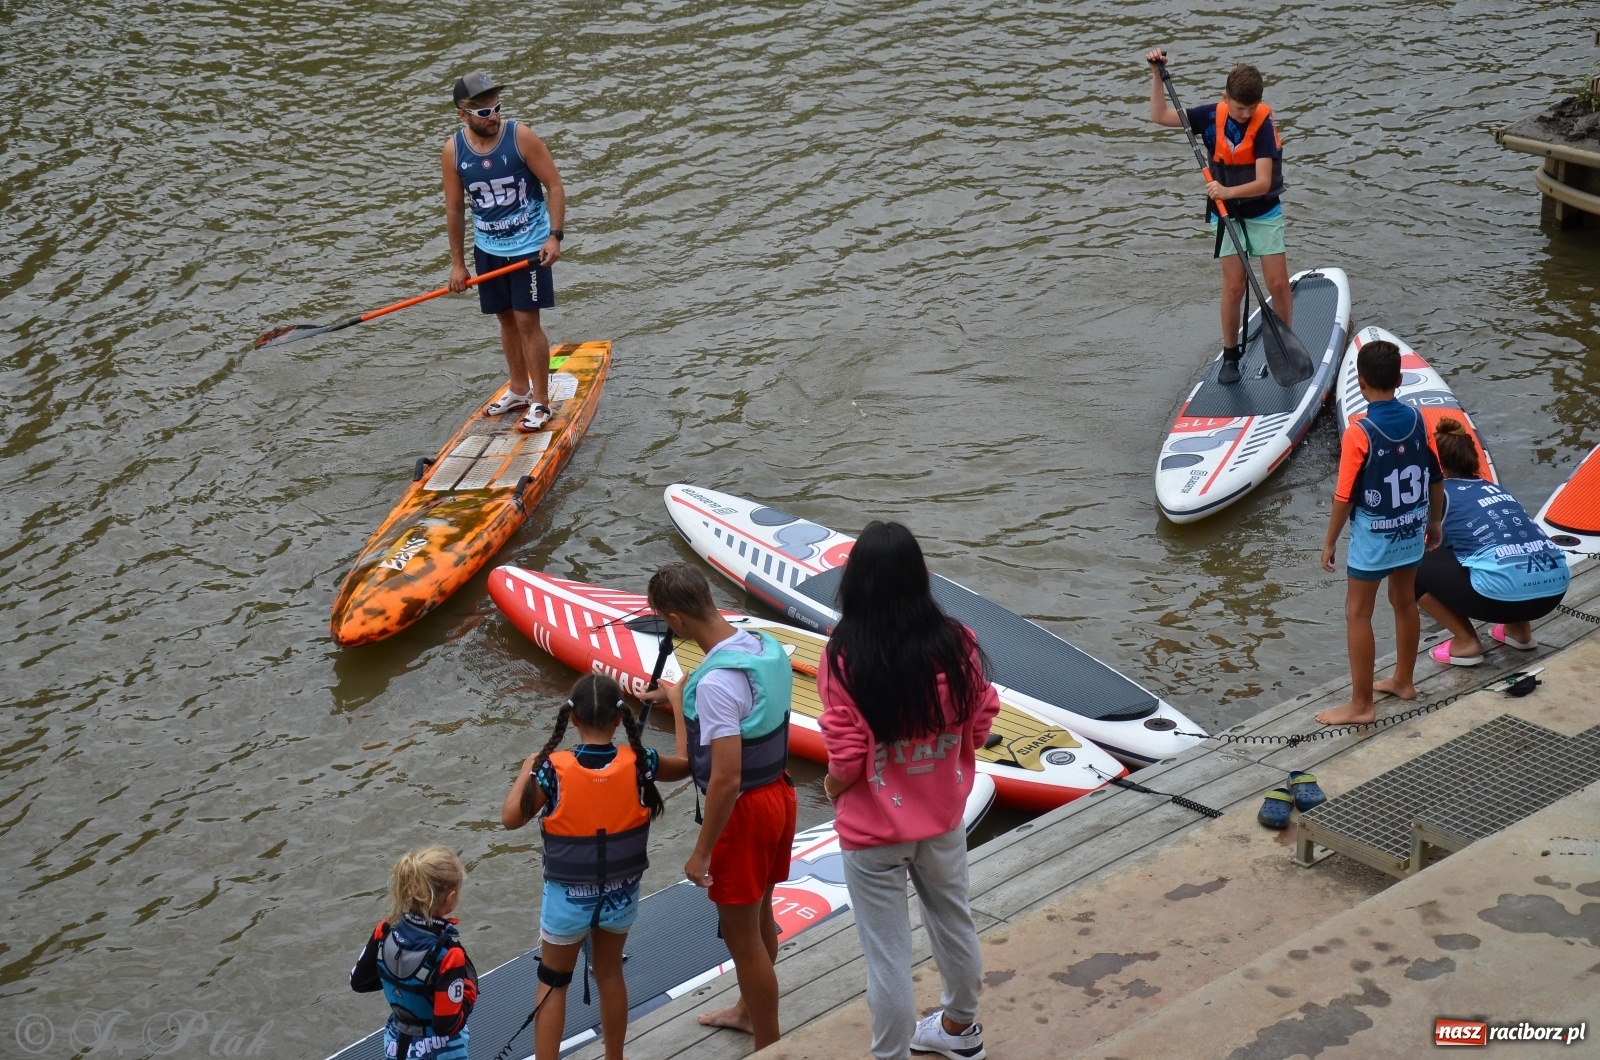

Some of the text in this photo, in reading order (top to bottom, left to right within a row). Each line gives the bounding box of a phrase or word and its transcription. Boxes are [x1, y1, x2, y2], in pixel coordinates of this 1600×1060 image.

[469, 176, 517, 208] 35
[1383, 464, 1422, 509] 13
[1016, 732, 1057, 756] SHARK
[454, 985, 462, 998] B
